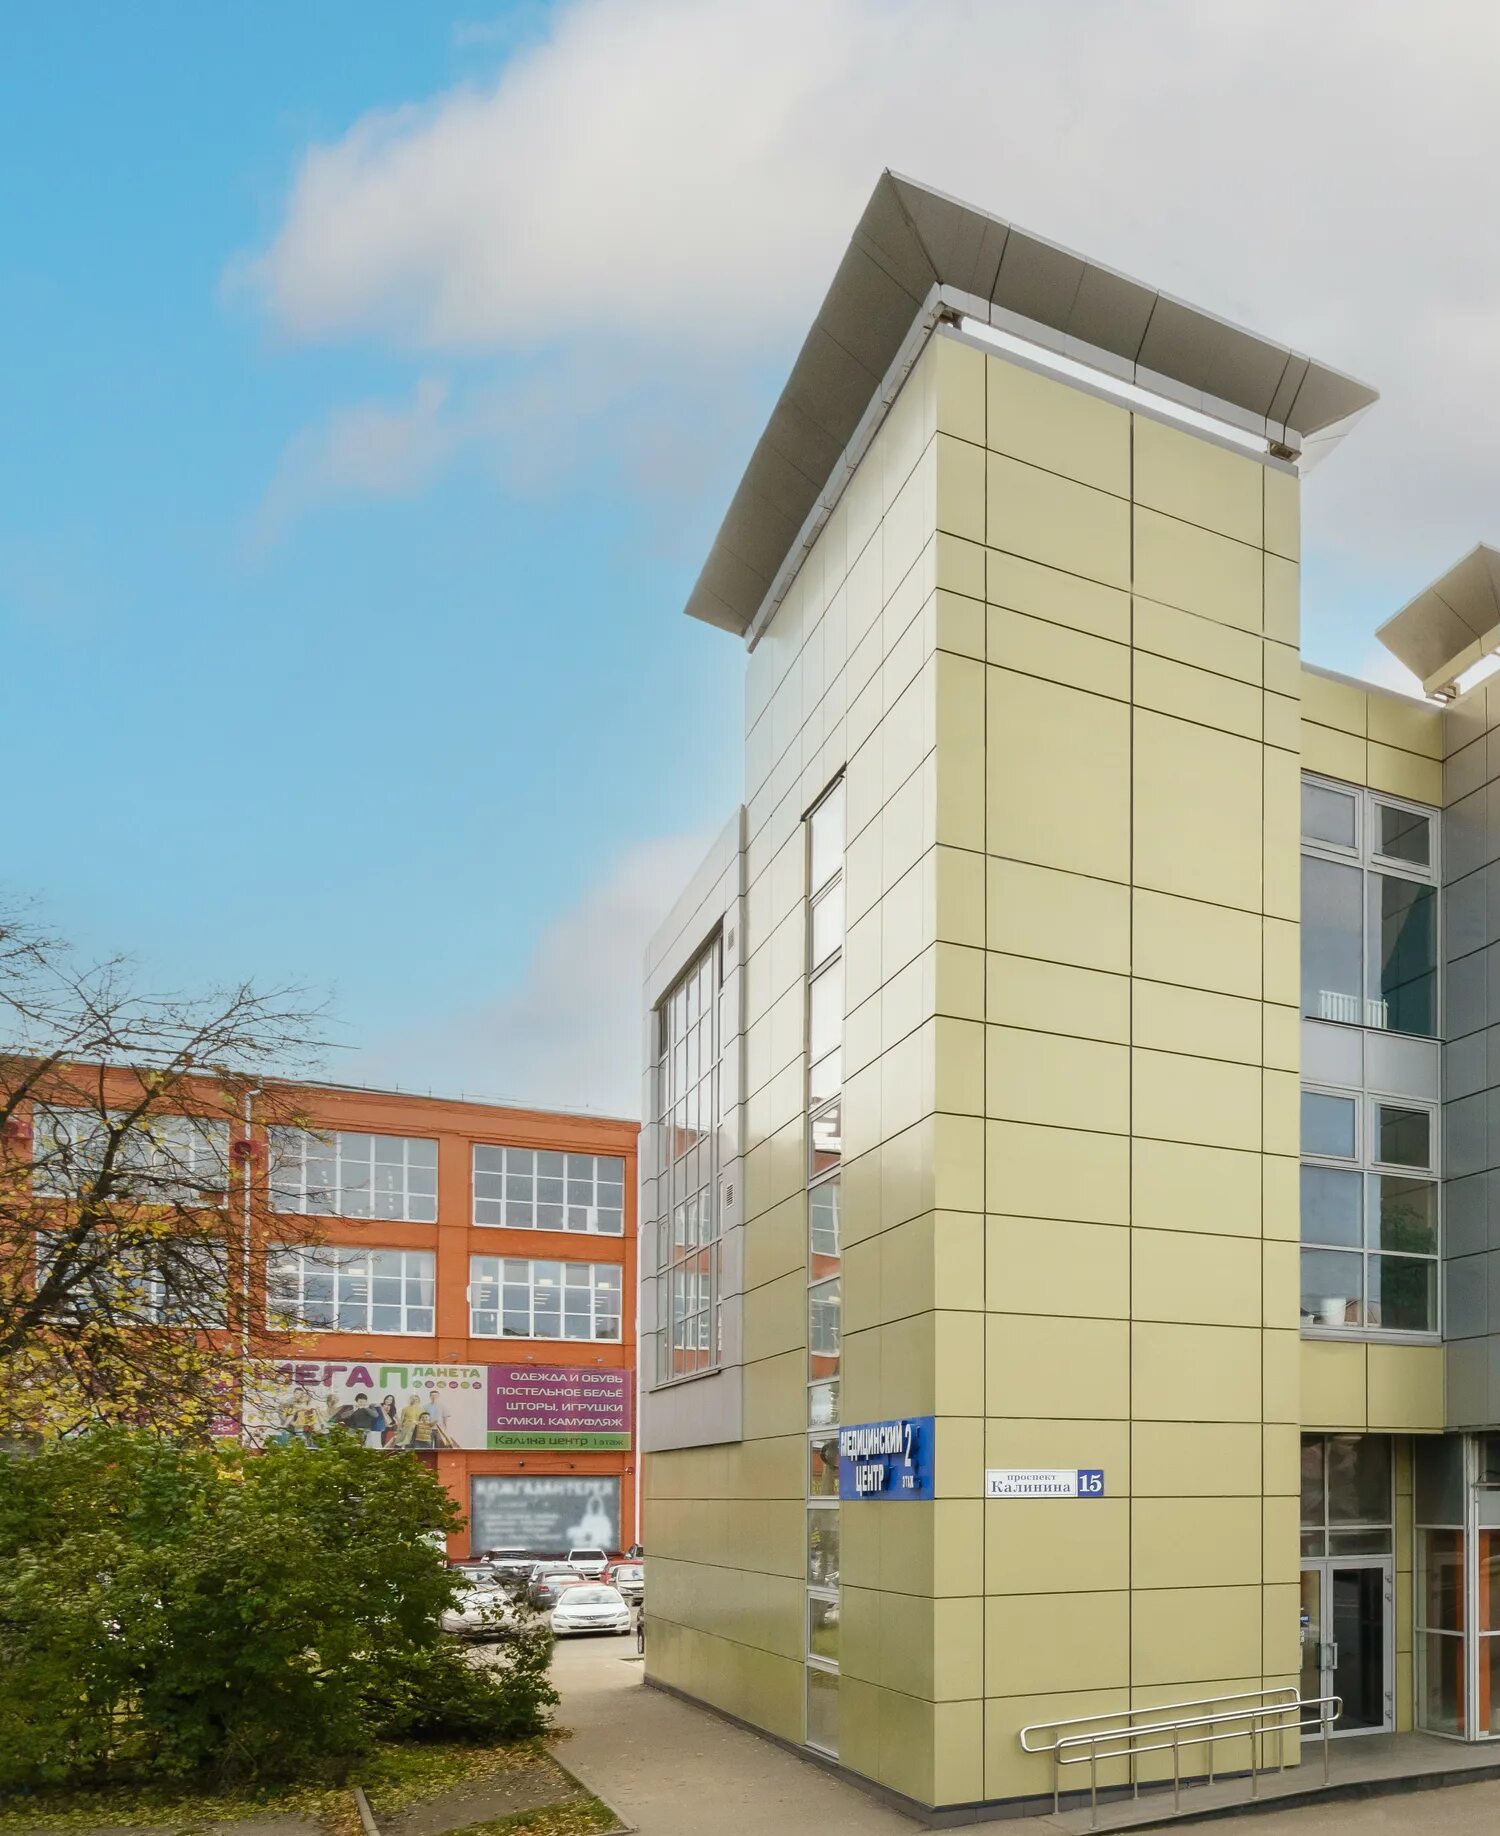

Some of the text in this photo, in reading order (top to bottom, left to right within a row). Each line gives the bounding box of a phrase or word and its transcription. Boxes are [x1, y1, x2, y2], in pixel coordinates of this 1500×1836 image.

[510, 1372, 623, 1383] ОДЕЖДА И ОБУВЬ
[496, 1387, 623, 1398] ПОСТЕЛЬНОЕ БЕЛЬЁ
[506, 1402, 623, 1412] ШТОРЫ, ИГРУШКИ
[548, 1418, 623, 1427] КАМУФЛЯЖ
[495, 1435, 546, 1445] Калина
[549, 1436, 588, 1447] центр
[841, 1421, 902, 1461] МЕДИЦИНСКИЙ
[904, 1424, 912, 1467] 2
[856, 1464, 884, 1496] ЦЕНТР
[1007, 1473, 1057, 1482] проспект
[1079, 1474, 1102, 1492] 15
[991, 1480, 1071, 1493] Калинина
